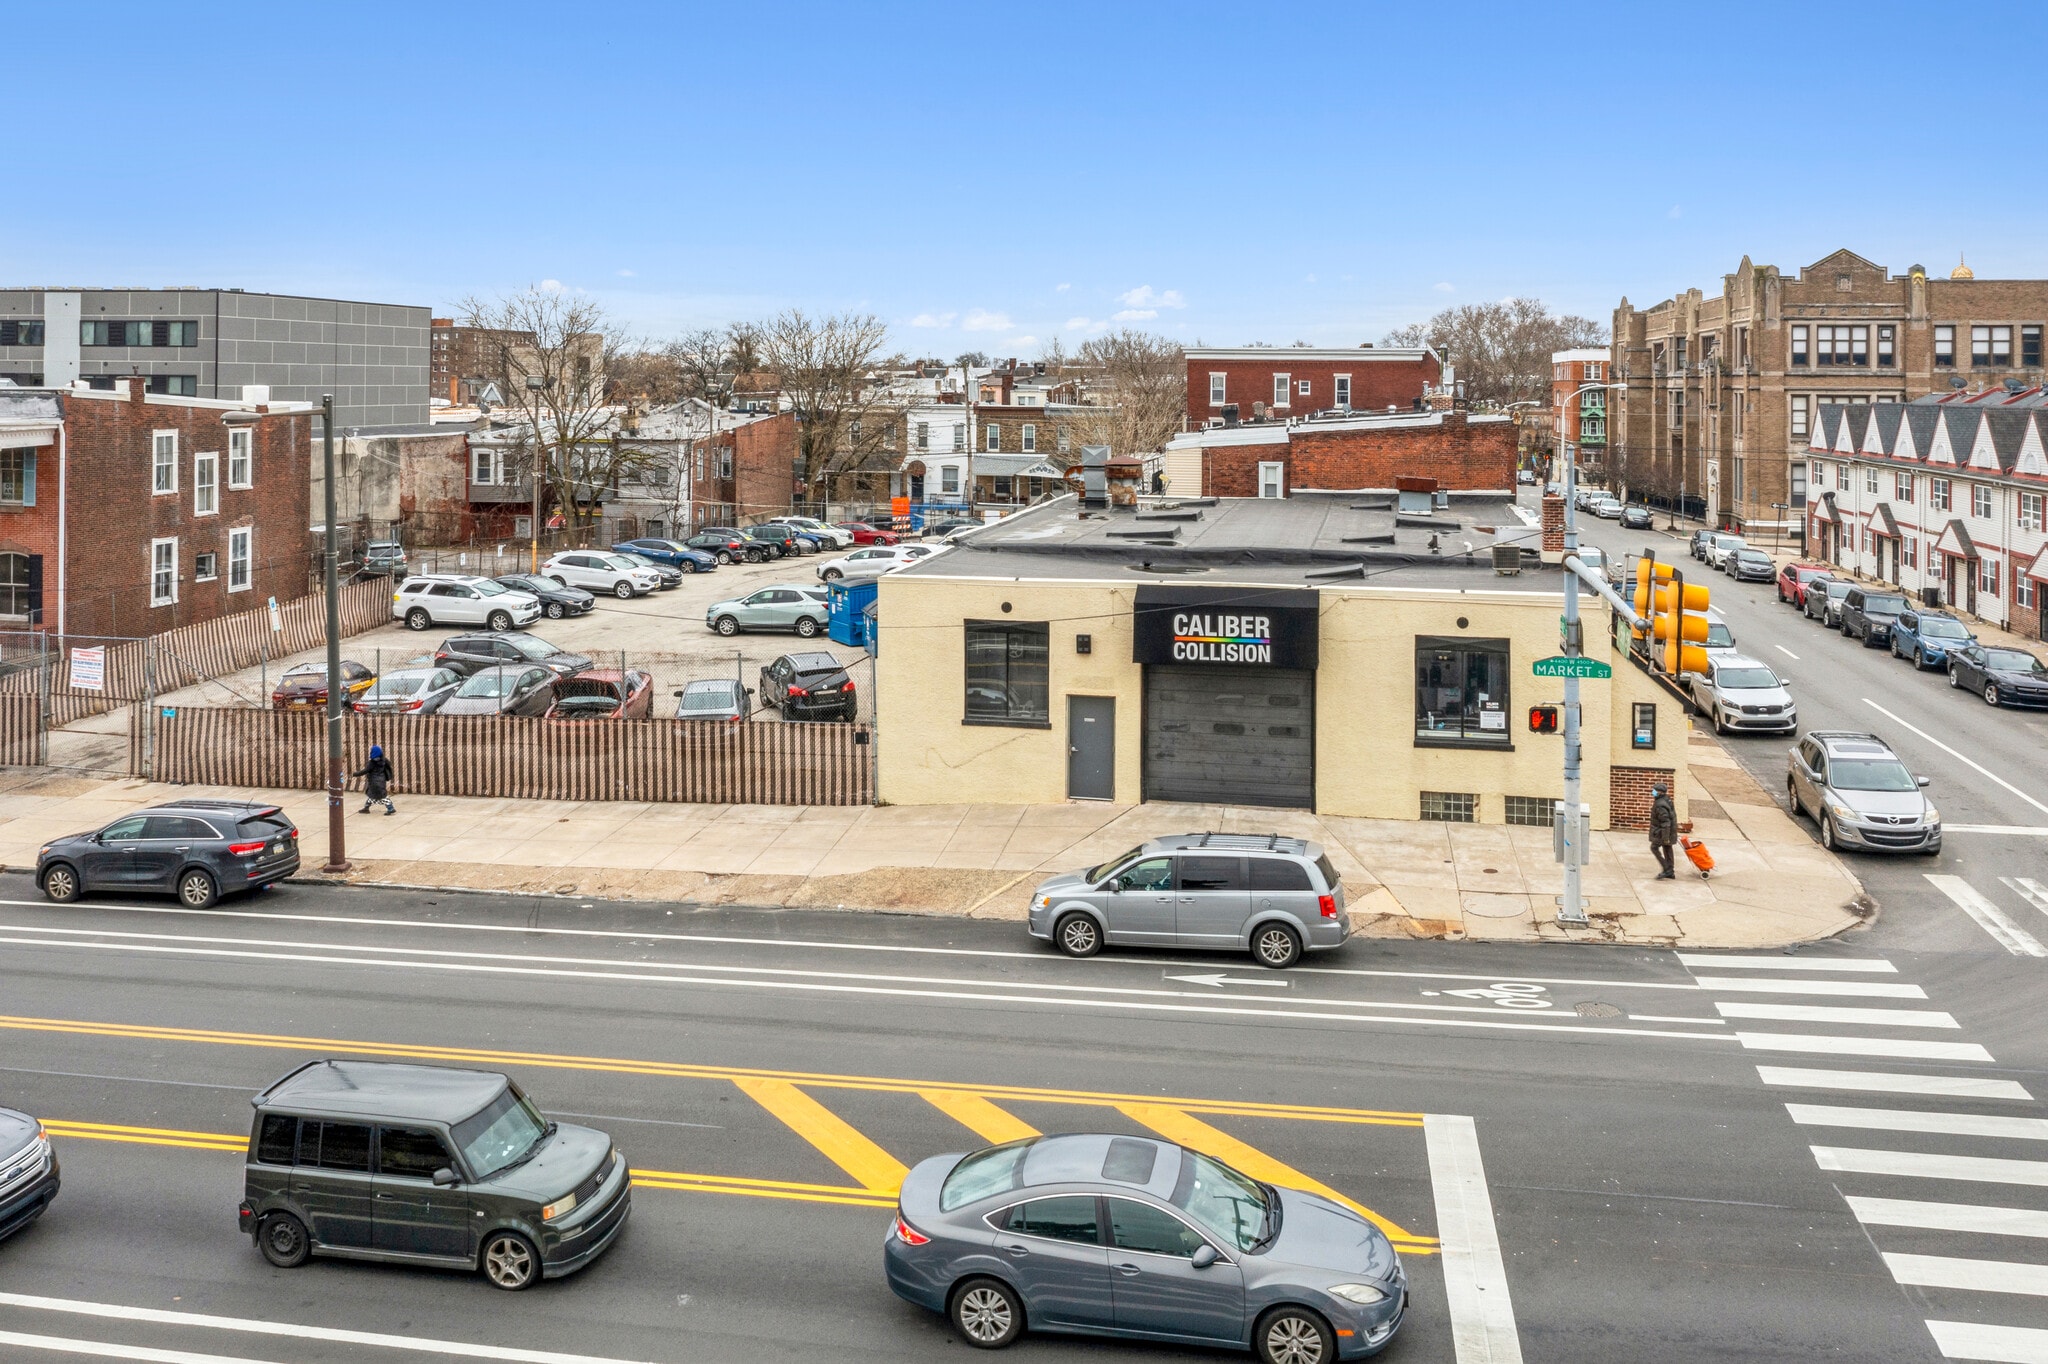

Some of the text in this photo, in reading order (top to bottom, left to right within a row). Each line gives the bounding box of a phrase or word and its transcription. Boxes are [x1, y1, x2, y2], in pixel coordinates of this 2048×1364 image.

[1173, 613, 1270, 638] CALIBER
[1173, 641, 1271, 663] COLLISION
[1536, 665, 1608, 678] MARKET ST
